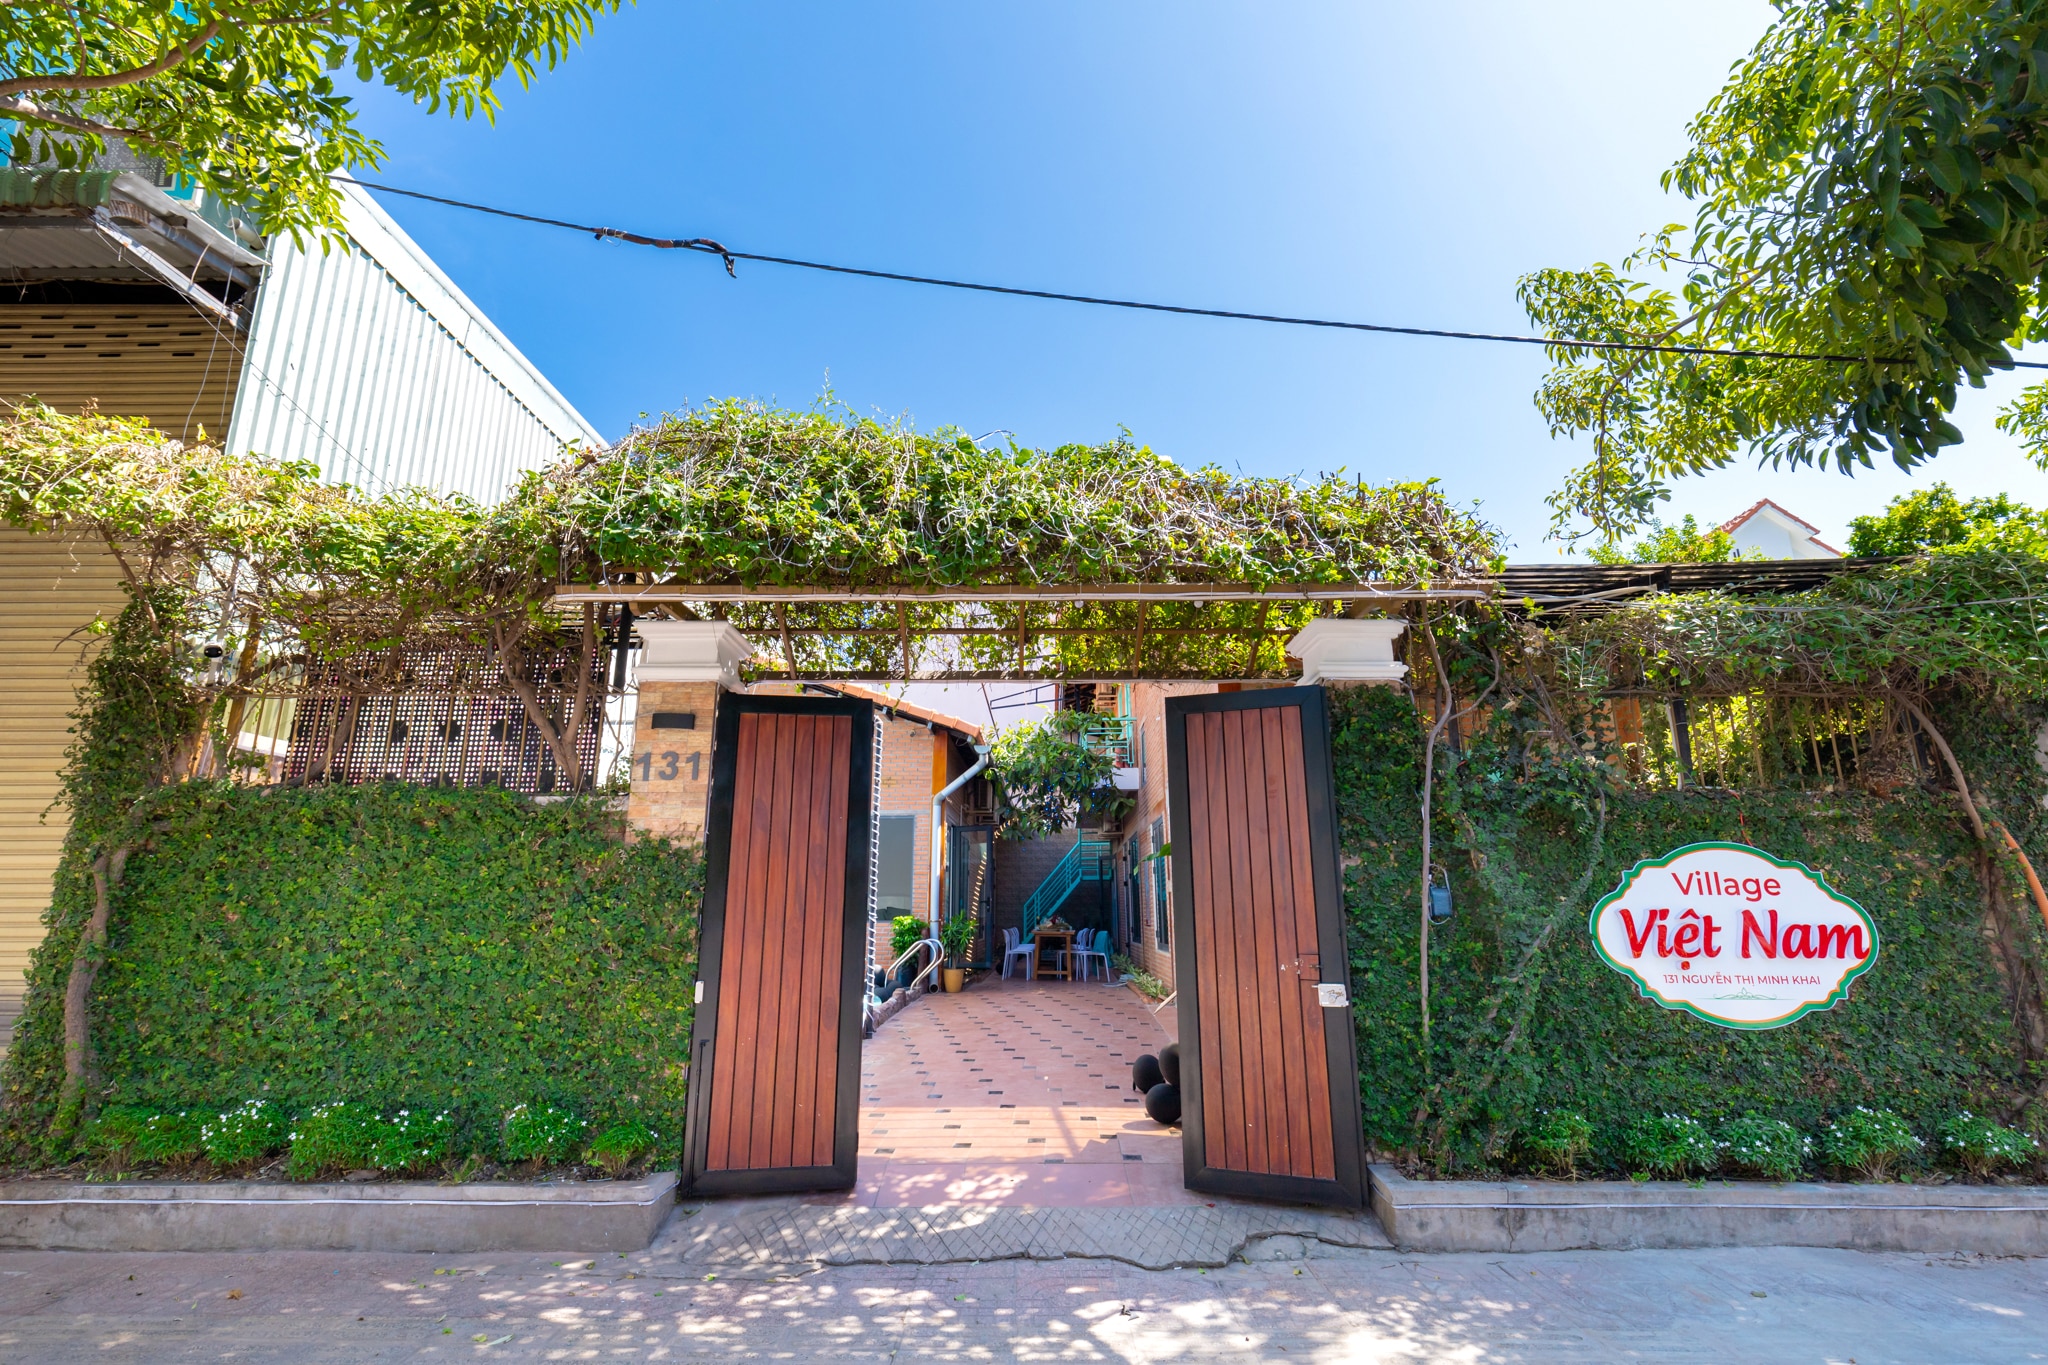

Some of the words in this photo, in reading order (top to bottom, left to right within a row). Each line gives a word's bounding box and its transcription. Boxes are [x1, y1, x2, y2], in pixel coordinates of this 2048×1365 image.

[636, 751, 700, 781] 131
[1671, 870, 1781, 902] Village
[1618, 908, 1722, 970] Việt
[1741, 908, 1870, 960] Nam
[1663, 974, 1679, 984] 131
[1681, 972, 1732, 985] NGUYỄN
[1734, 975, 1755, 986] THỊ
[1757, 975, 1789, 985] MINH
[1792, 975, 1821, 985] KHAI
